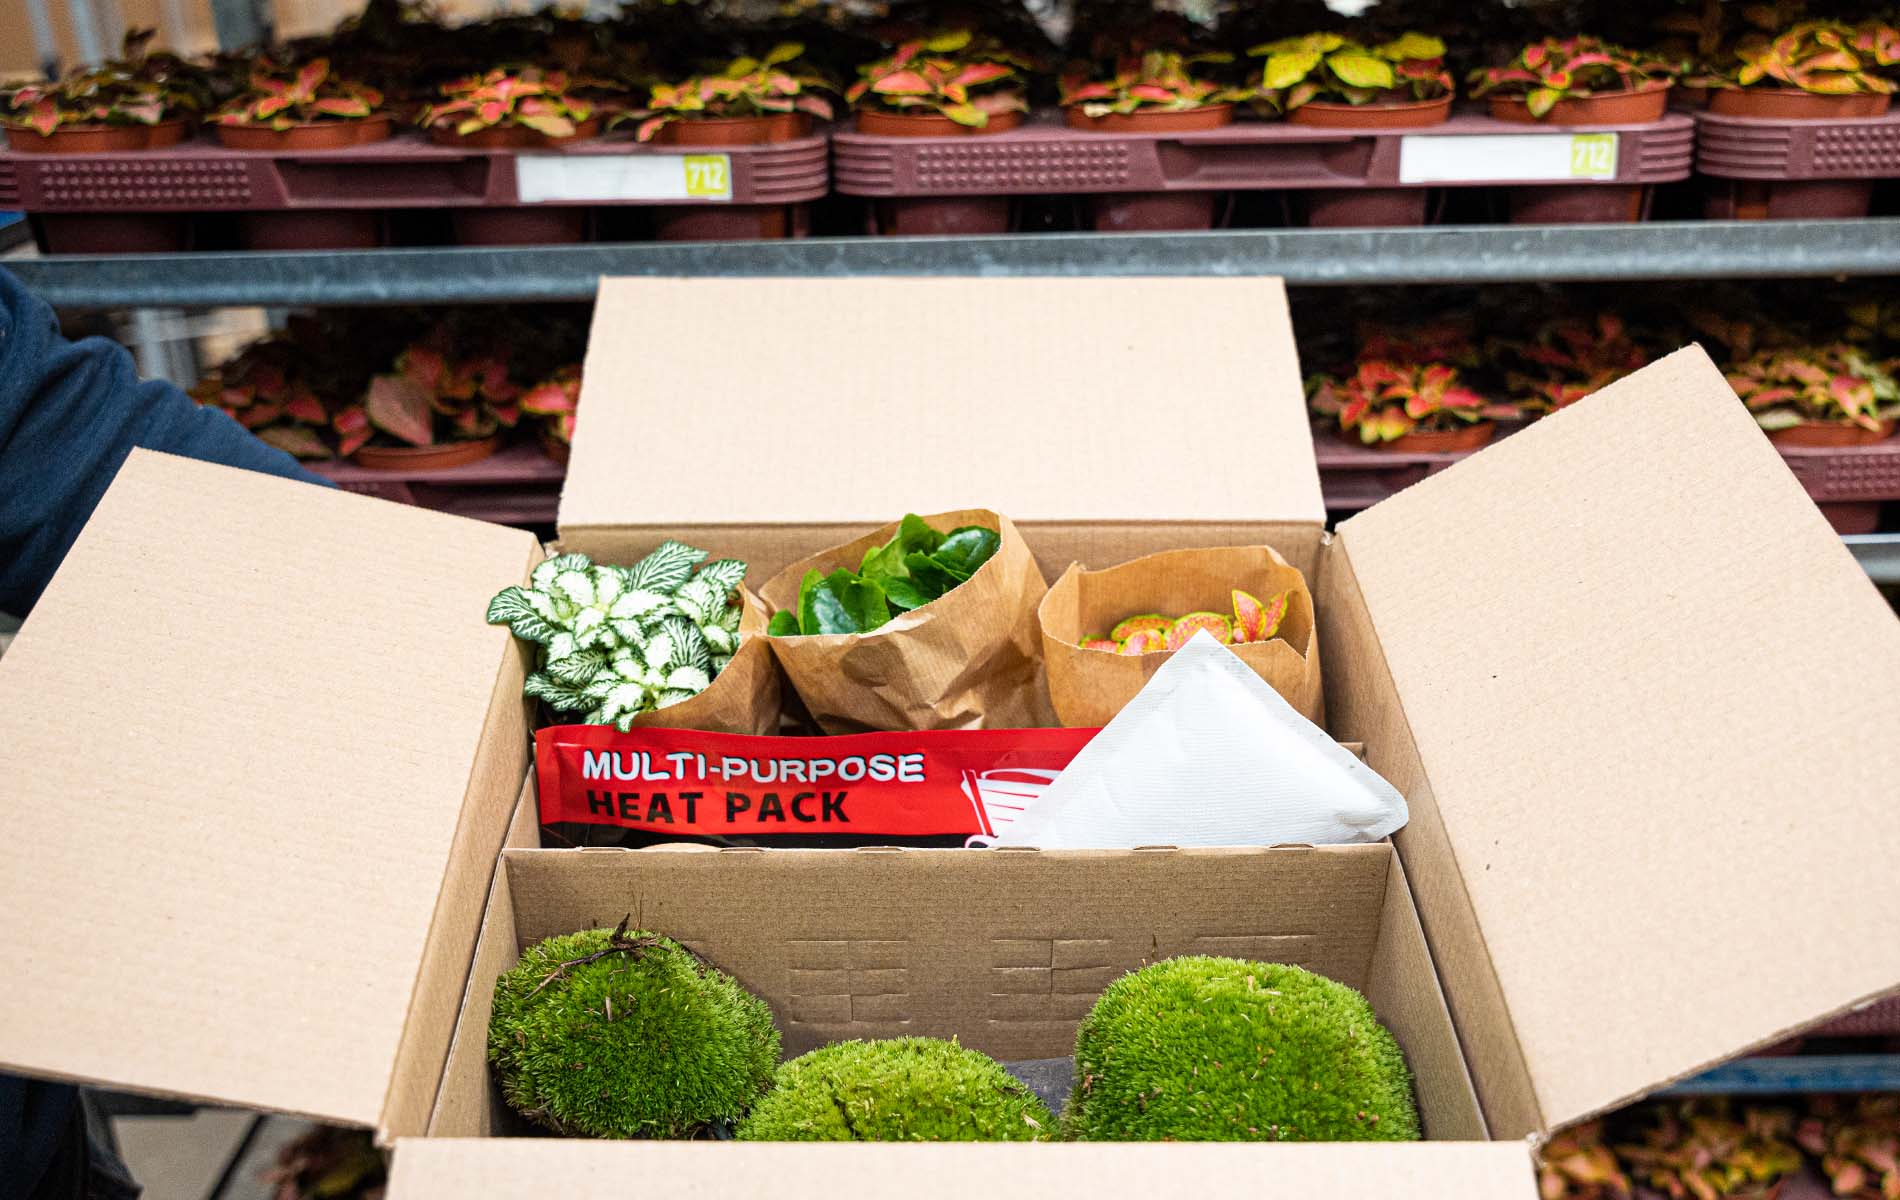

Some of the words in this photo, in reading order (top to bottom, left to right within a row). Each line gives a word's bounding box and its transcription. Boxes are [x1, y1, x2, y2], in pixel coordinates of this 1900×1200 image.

[1575, 142, 1611, 170] 712
[689, 163, 723, 191] 712
[582, 750, 926, 783] MULTI-PURPOSE
[588, 791, 703, 824] HEAT
[726, 791, 850, 823] PACK
